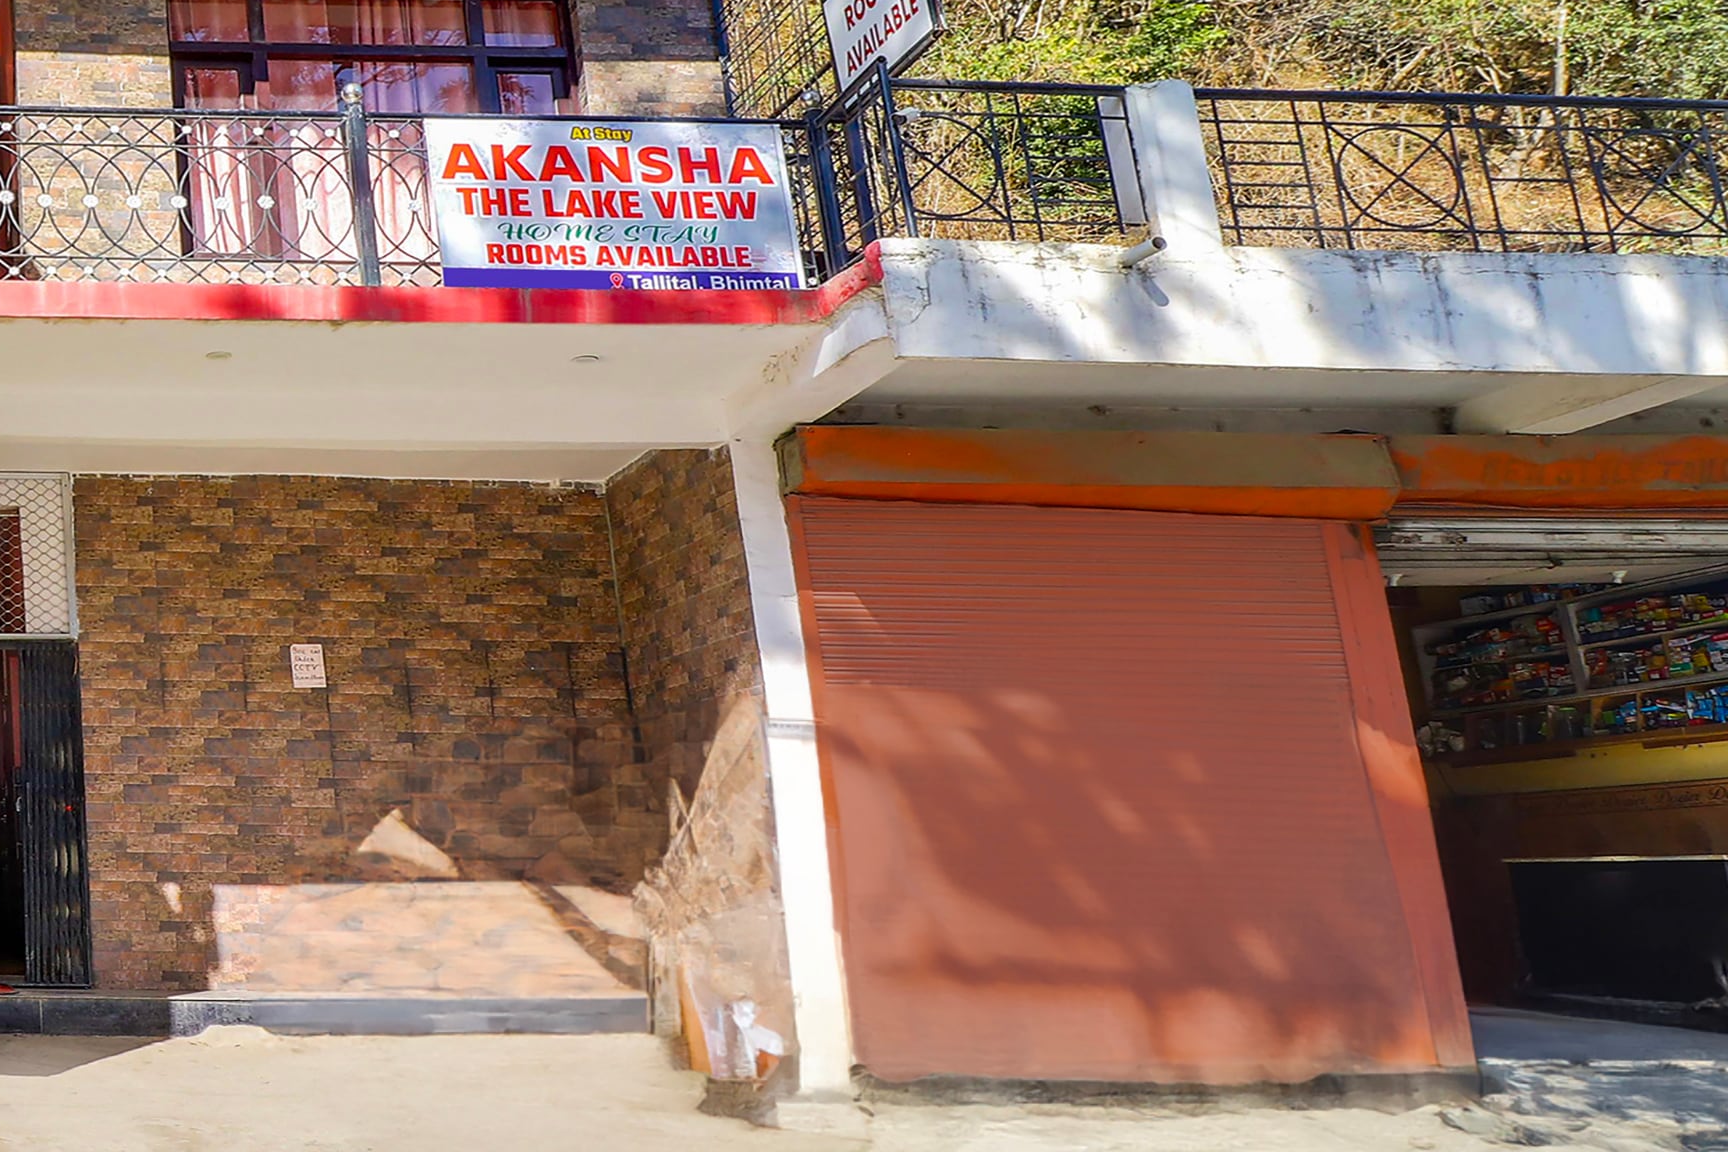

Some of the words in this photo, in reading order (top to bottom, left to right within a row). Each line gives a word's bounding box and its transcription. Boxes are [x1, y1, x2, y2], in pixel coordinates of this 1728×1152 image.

[571, 126, 593, 141] At
[594, 127, 633, 143] Stay
[441, 143, 776, 185] AKANSHA
[456, 187, 532, 218] THE
[542, 188, 642, 219] LAKE
[651, 190, 758, 220] VIEW
[486, 243, 587, 266] ROOMS
[595, 244, 752, 268] AVAILABLE
[710, 275, 791, 290] Bhimtal
